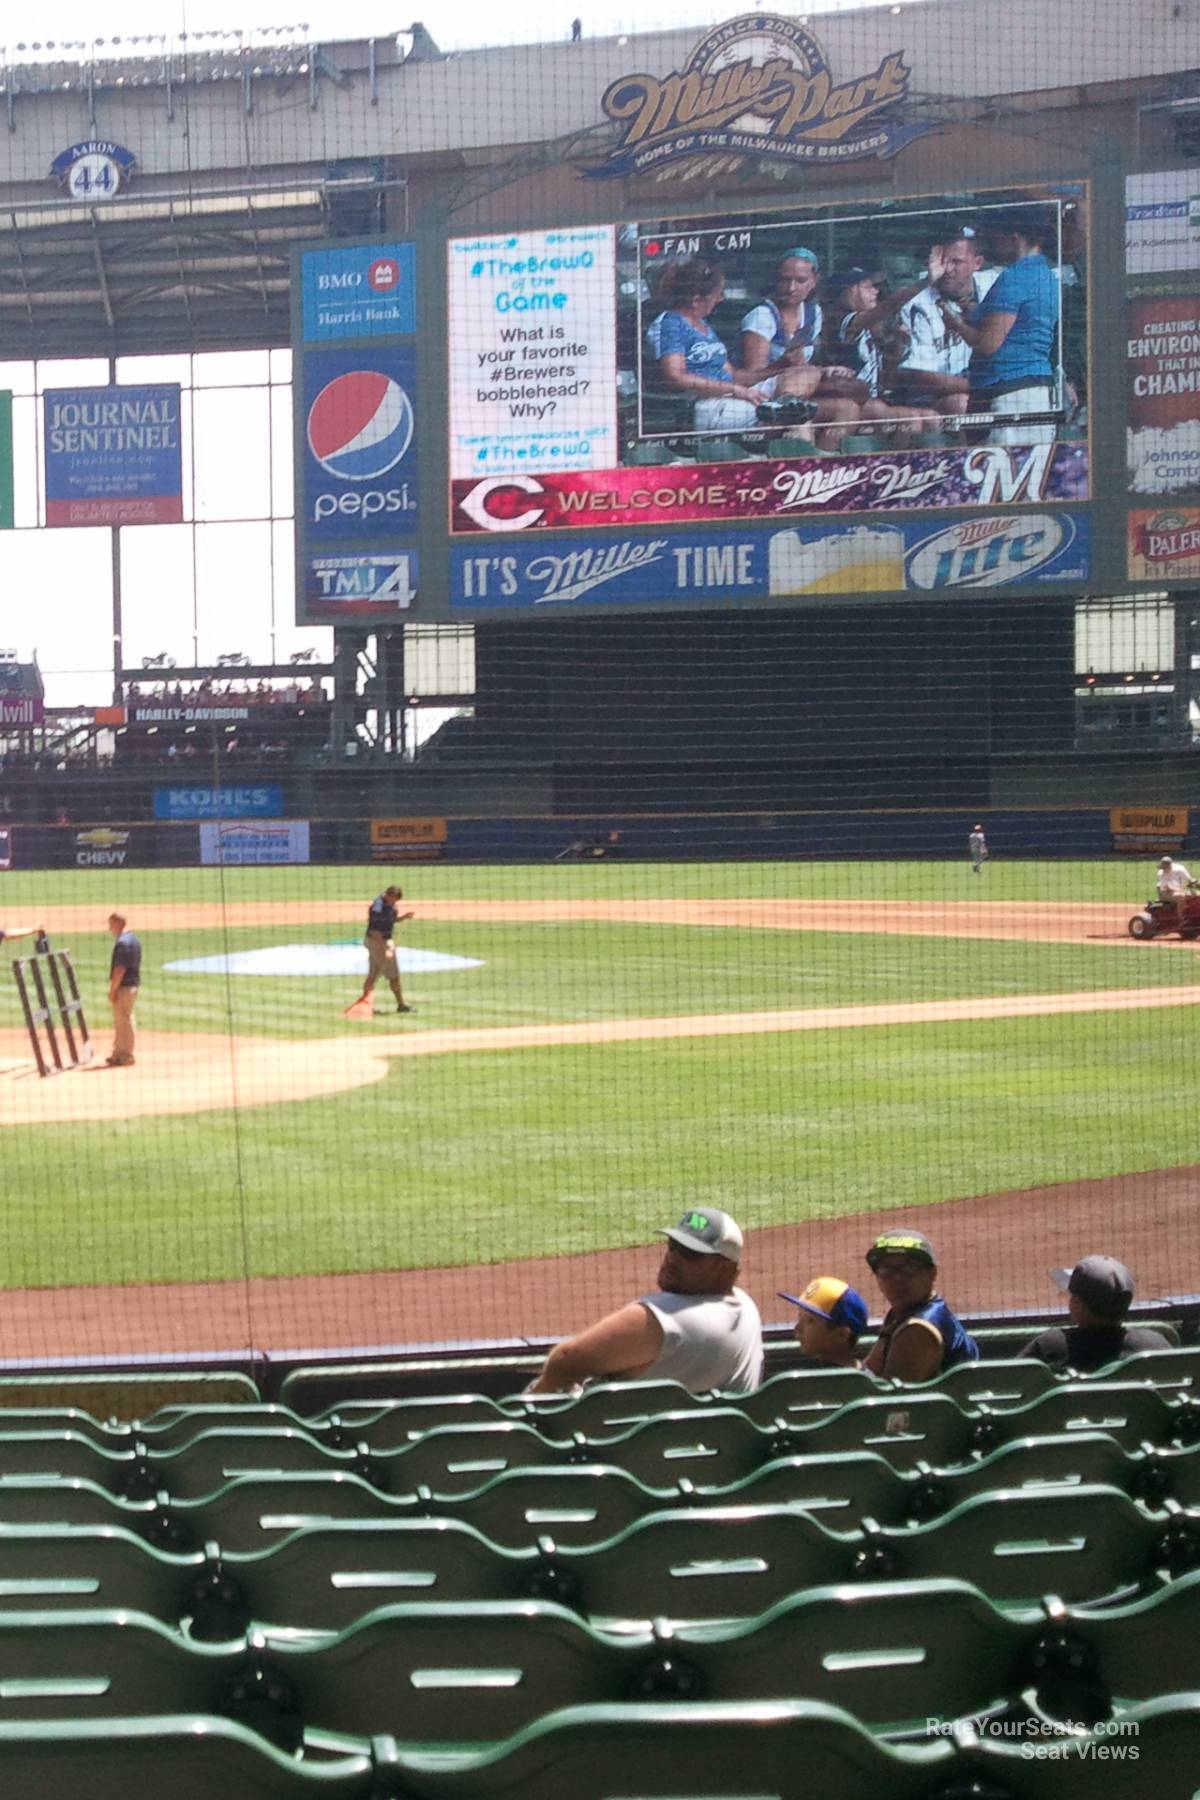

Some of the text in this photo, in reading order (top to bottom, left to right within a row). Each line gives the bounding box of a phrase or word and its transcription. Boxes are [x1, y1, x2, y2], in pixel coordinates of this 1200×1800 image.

[708, 19, 801, 48] SINCE 2001
[602, 50, 911, 152] Miller Park
[71, 142, 116, 160] AARON
[635, 132, 889, 167] HOME OF THE MILWAUKEE BREWERS
[74, 164, 114, 194] 44
[664, 232, 751, 254] FAN CAM
[318, 272, 362, 289] BMO
[496, 292, 568, 313] Game
[318, 306, 400, 325] Harris Bank
[500, 325, 565, 343] What is
[1143, 320, 1196, 335] CREATING
[478, 343, 588, 367] your favorite
[1158, 357, 1186, 371] THAT
[490, 365, 576, 382] #Brewers
[477, 380, 591, 402] bobblehead?
[50, 400, 177, 430] JOURNAL
[509, 401, 557, 420] Why?
[50, 425, 177, 453] SENTINEL
[558, 460, 951, 513] WELCOME TO Miller Park
[315, 483, 409, 522] pepsi
[954, 518, 1021, 547] Miller
[930, 530, 1045, 587] Lite
[462, 540, 755, 603] IT'S Miller TIME
[136, 707, 249, 721] HARLEY-DAVIDSON
[169, 788, 267, 806] KOHL'S
[76, 851, 126, 865] CHEVY
